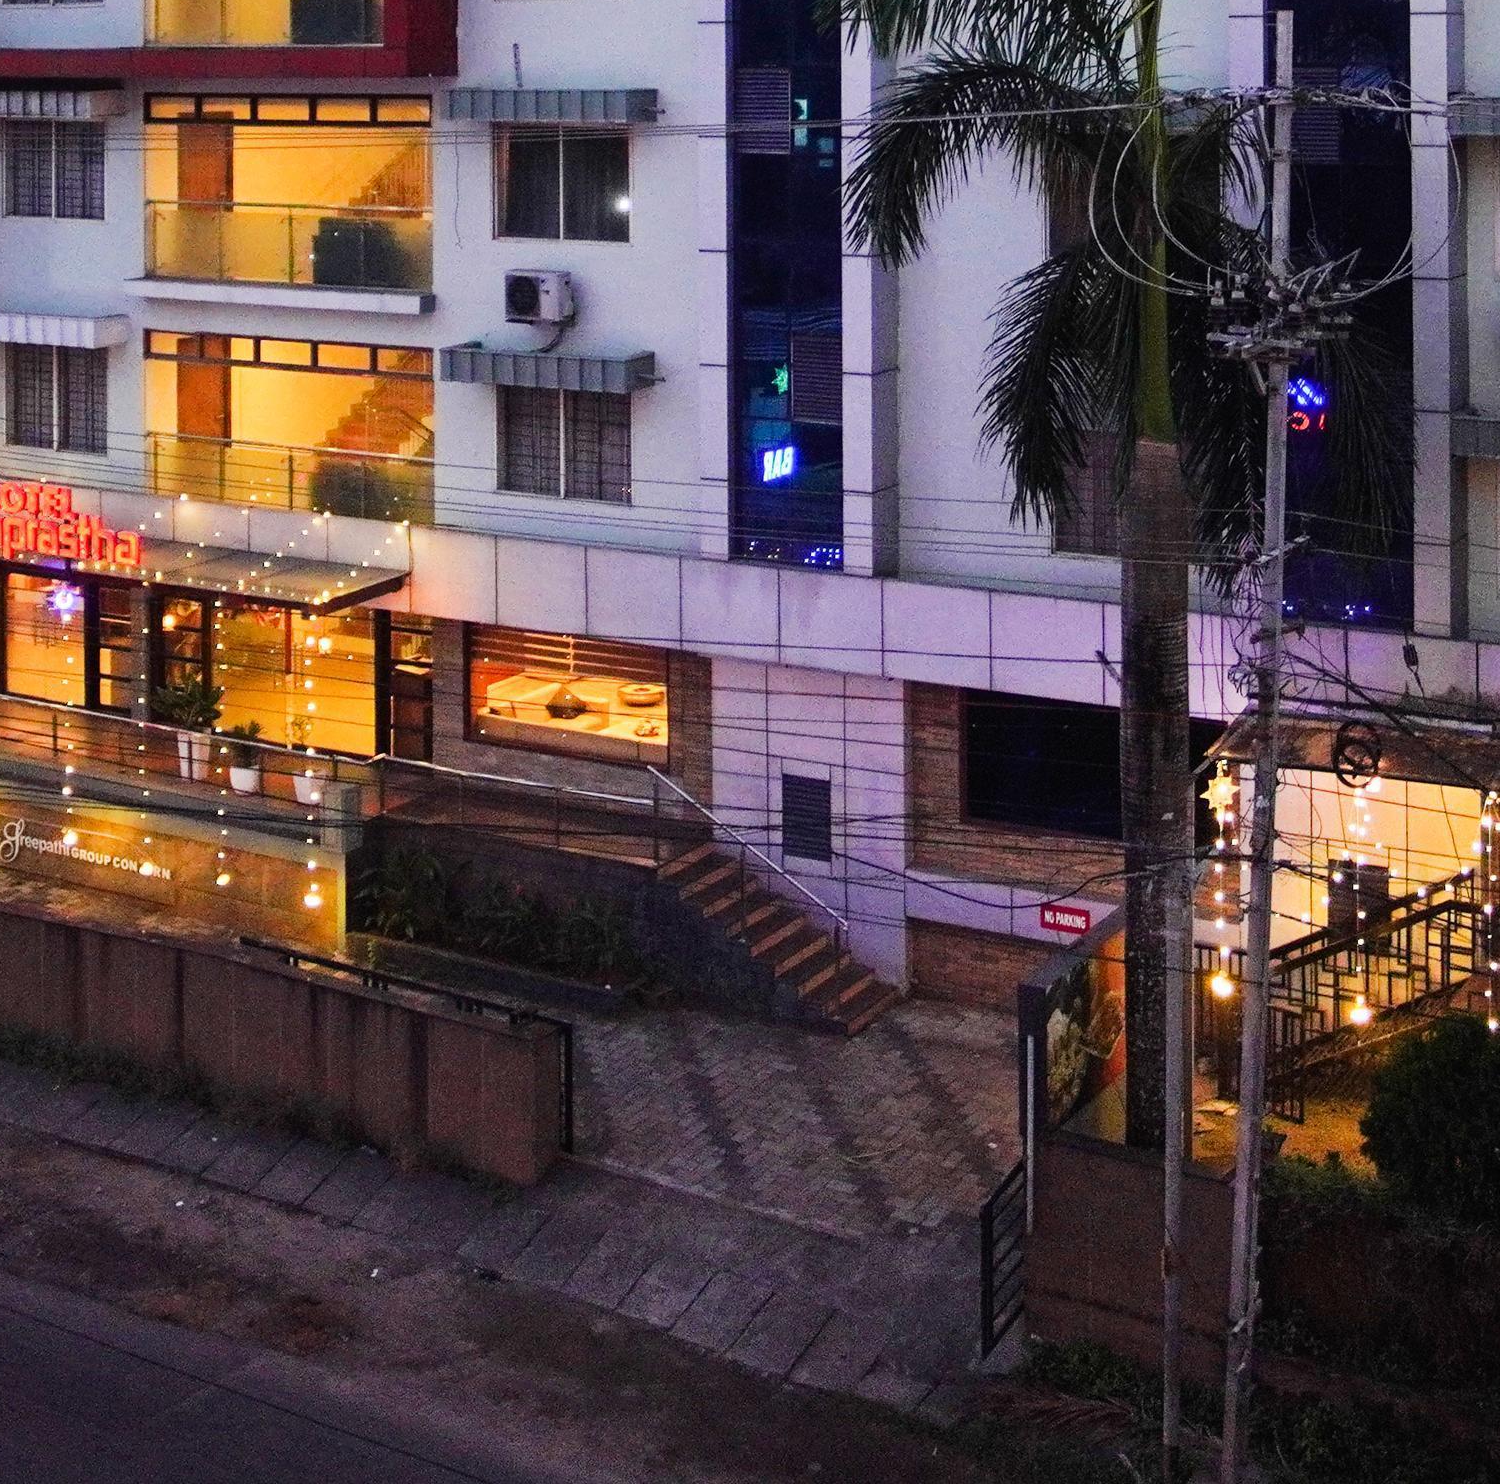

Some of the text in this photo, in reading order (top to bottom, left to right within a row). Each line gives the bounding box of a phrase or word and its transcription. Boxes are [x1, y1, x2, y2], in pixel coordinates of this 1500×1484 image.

[71, 847, 111, 866] GROUP
[113, 856, 171, 880] CONRN
[1044, 911, 1086, 929] NO PARKING
